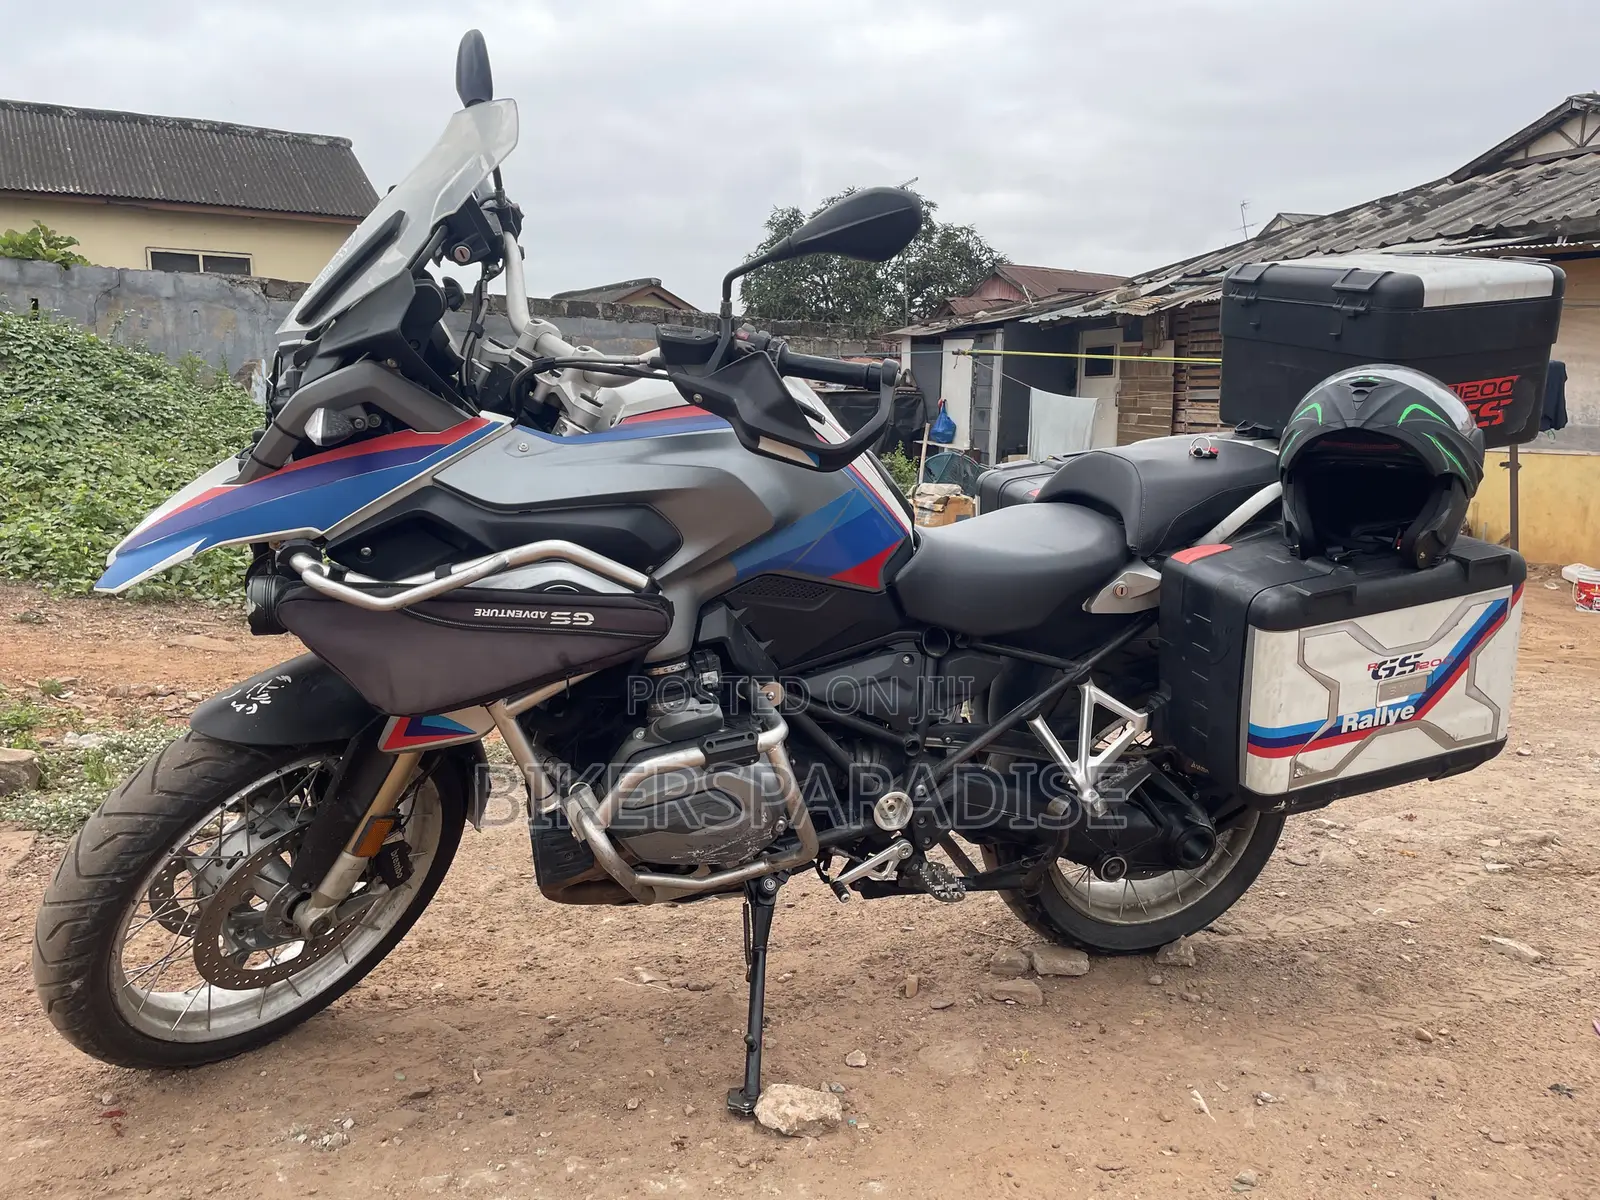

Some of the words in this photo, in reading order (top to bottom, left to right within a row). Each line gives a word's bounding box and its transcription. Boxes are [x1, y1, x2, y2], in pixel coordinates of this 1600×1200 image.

[473, 608, 548, 619] ADVENTURE
[549, 611, 595, 626] GS
[1341, 705, 1416, 734] Rallye
[390, 848, 404, 879] brembo
